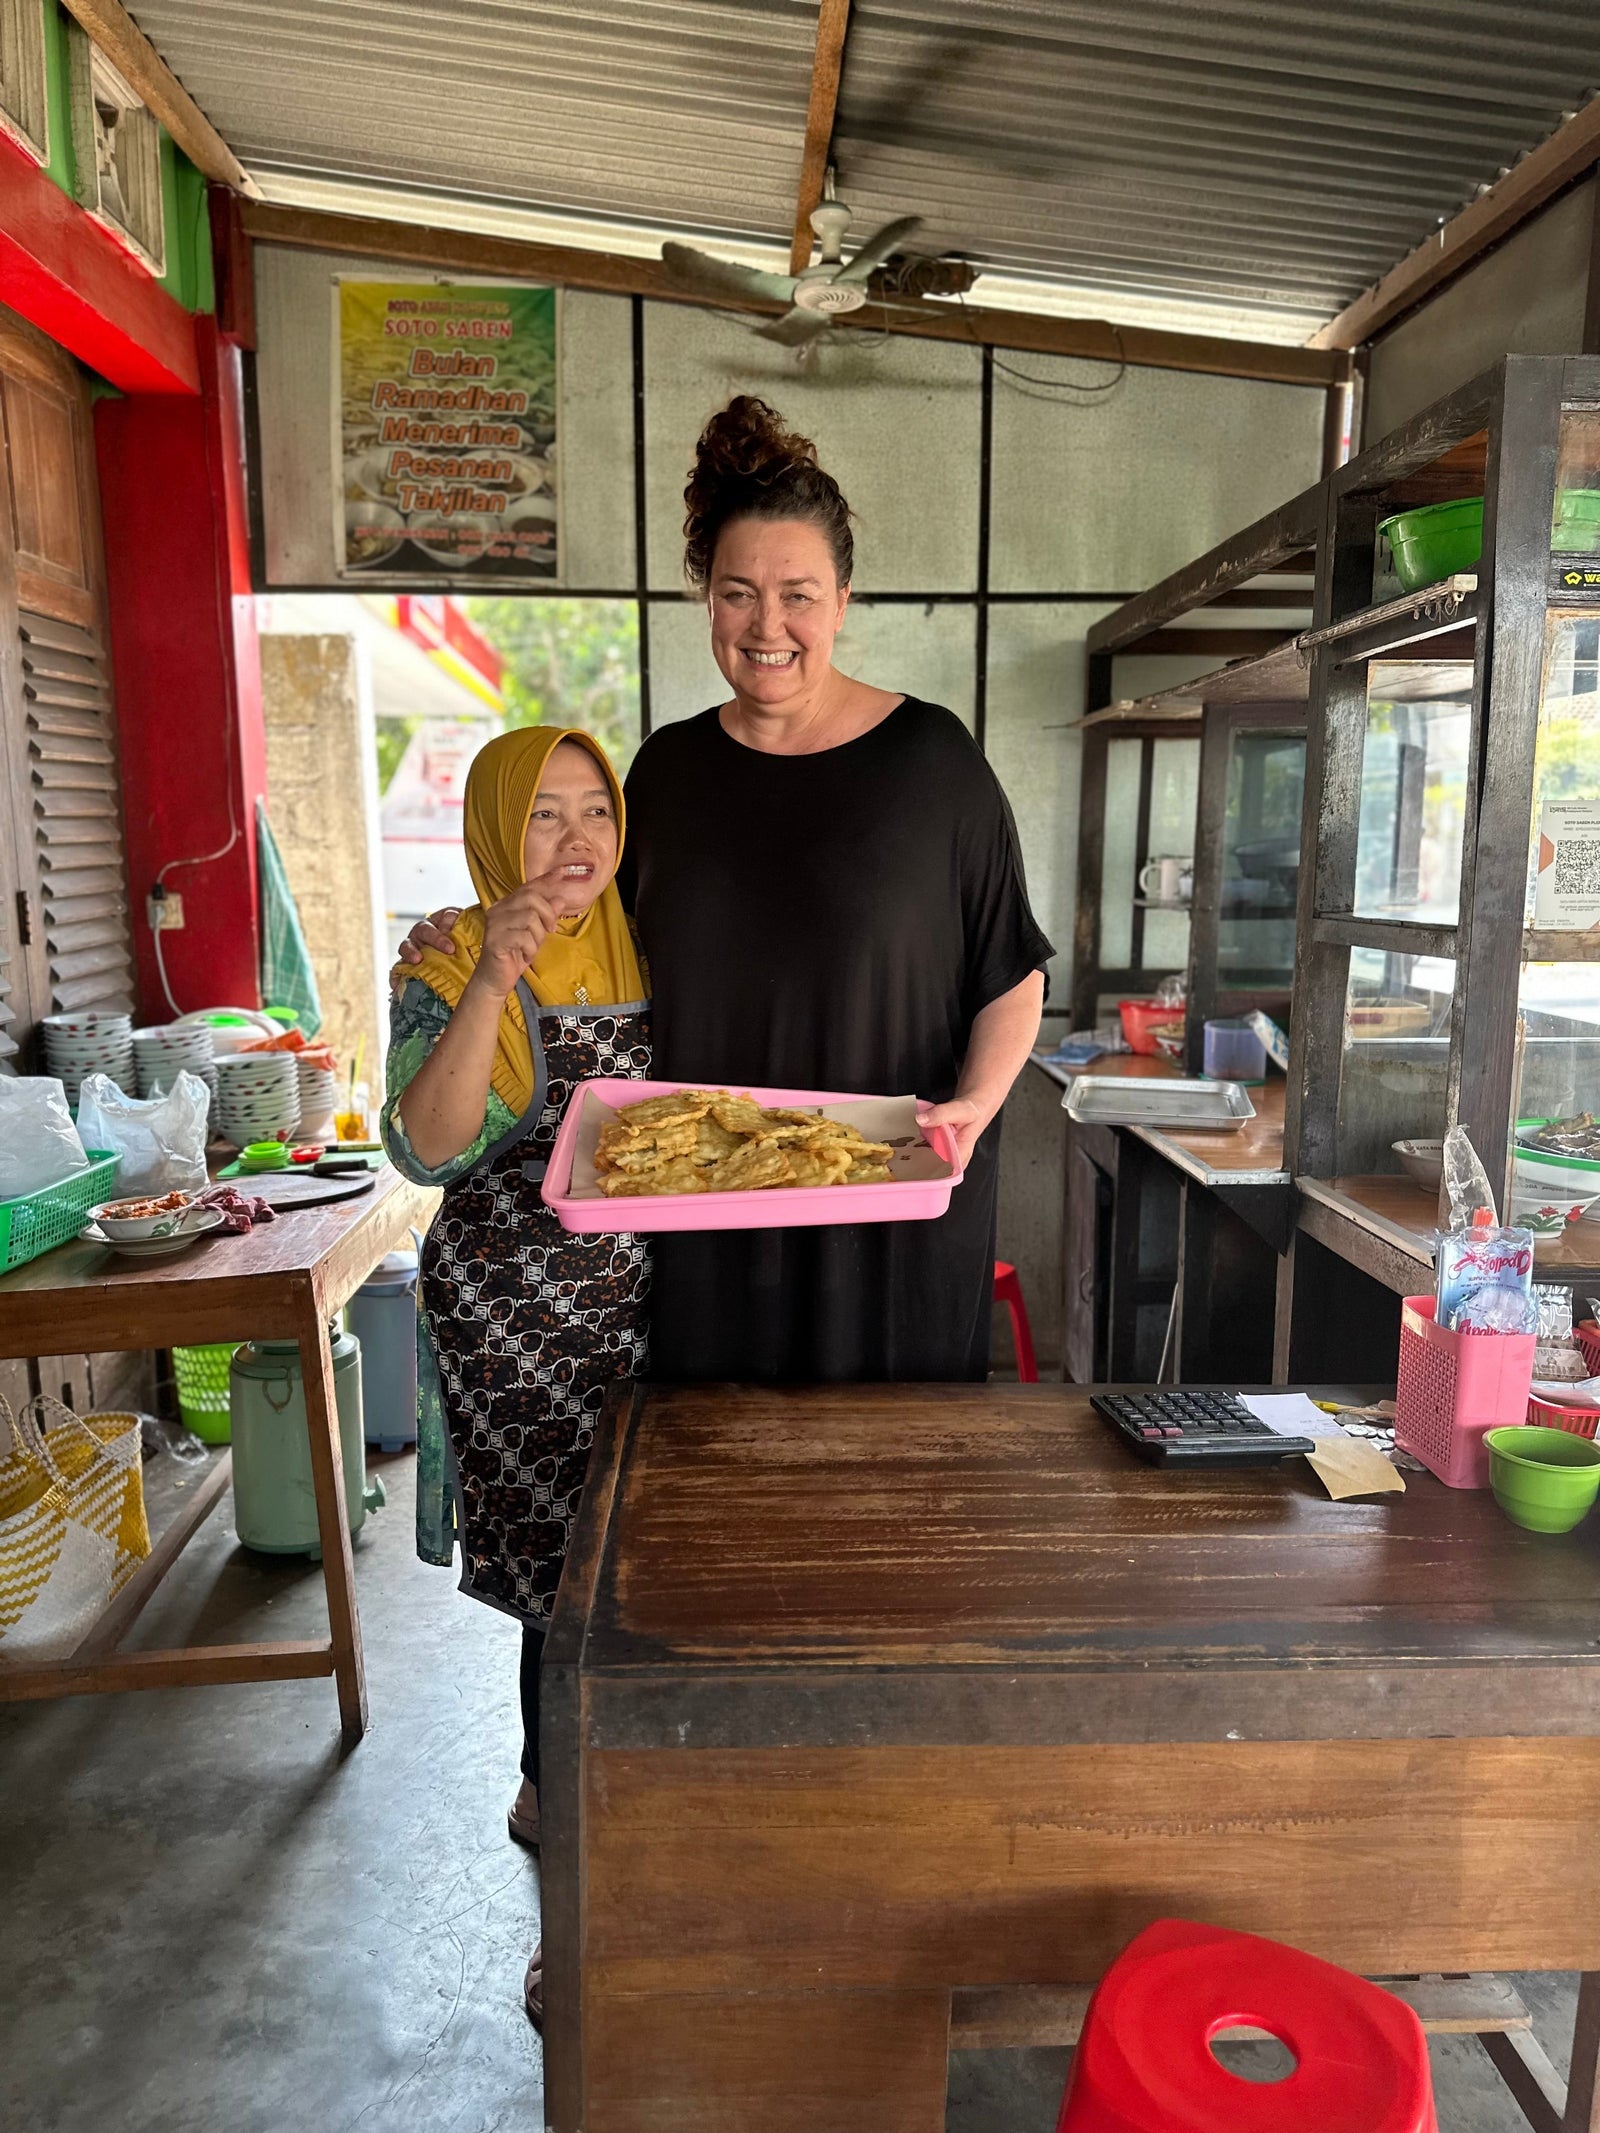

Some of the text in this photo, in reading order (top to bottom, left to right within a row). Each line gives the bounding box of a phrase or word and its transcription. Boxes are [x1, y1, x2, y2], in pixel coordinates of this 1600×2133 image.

[384, 319, 512, 338] SOTO SABEN
[411, 349, 495, 376] Bulan
[374, 381, 527, 411] Ramadhan
[381, 416, 520, 446] Menerima
[389, 450, 513, 479] Pesanan
[398, 485, 507, 516] Takjilan
